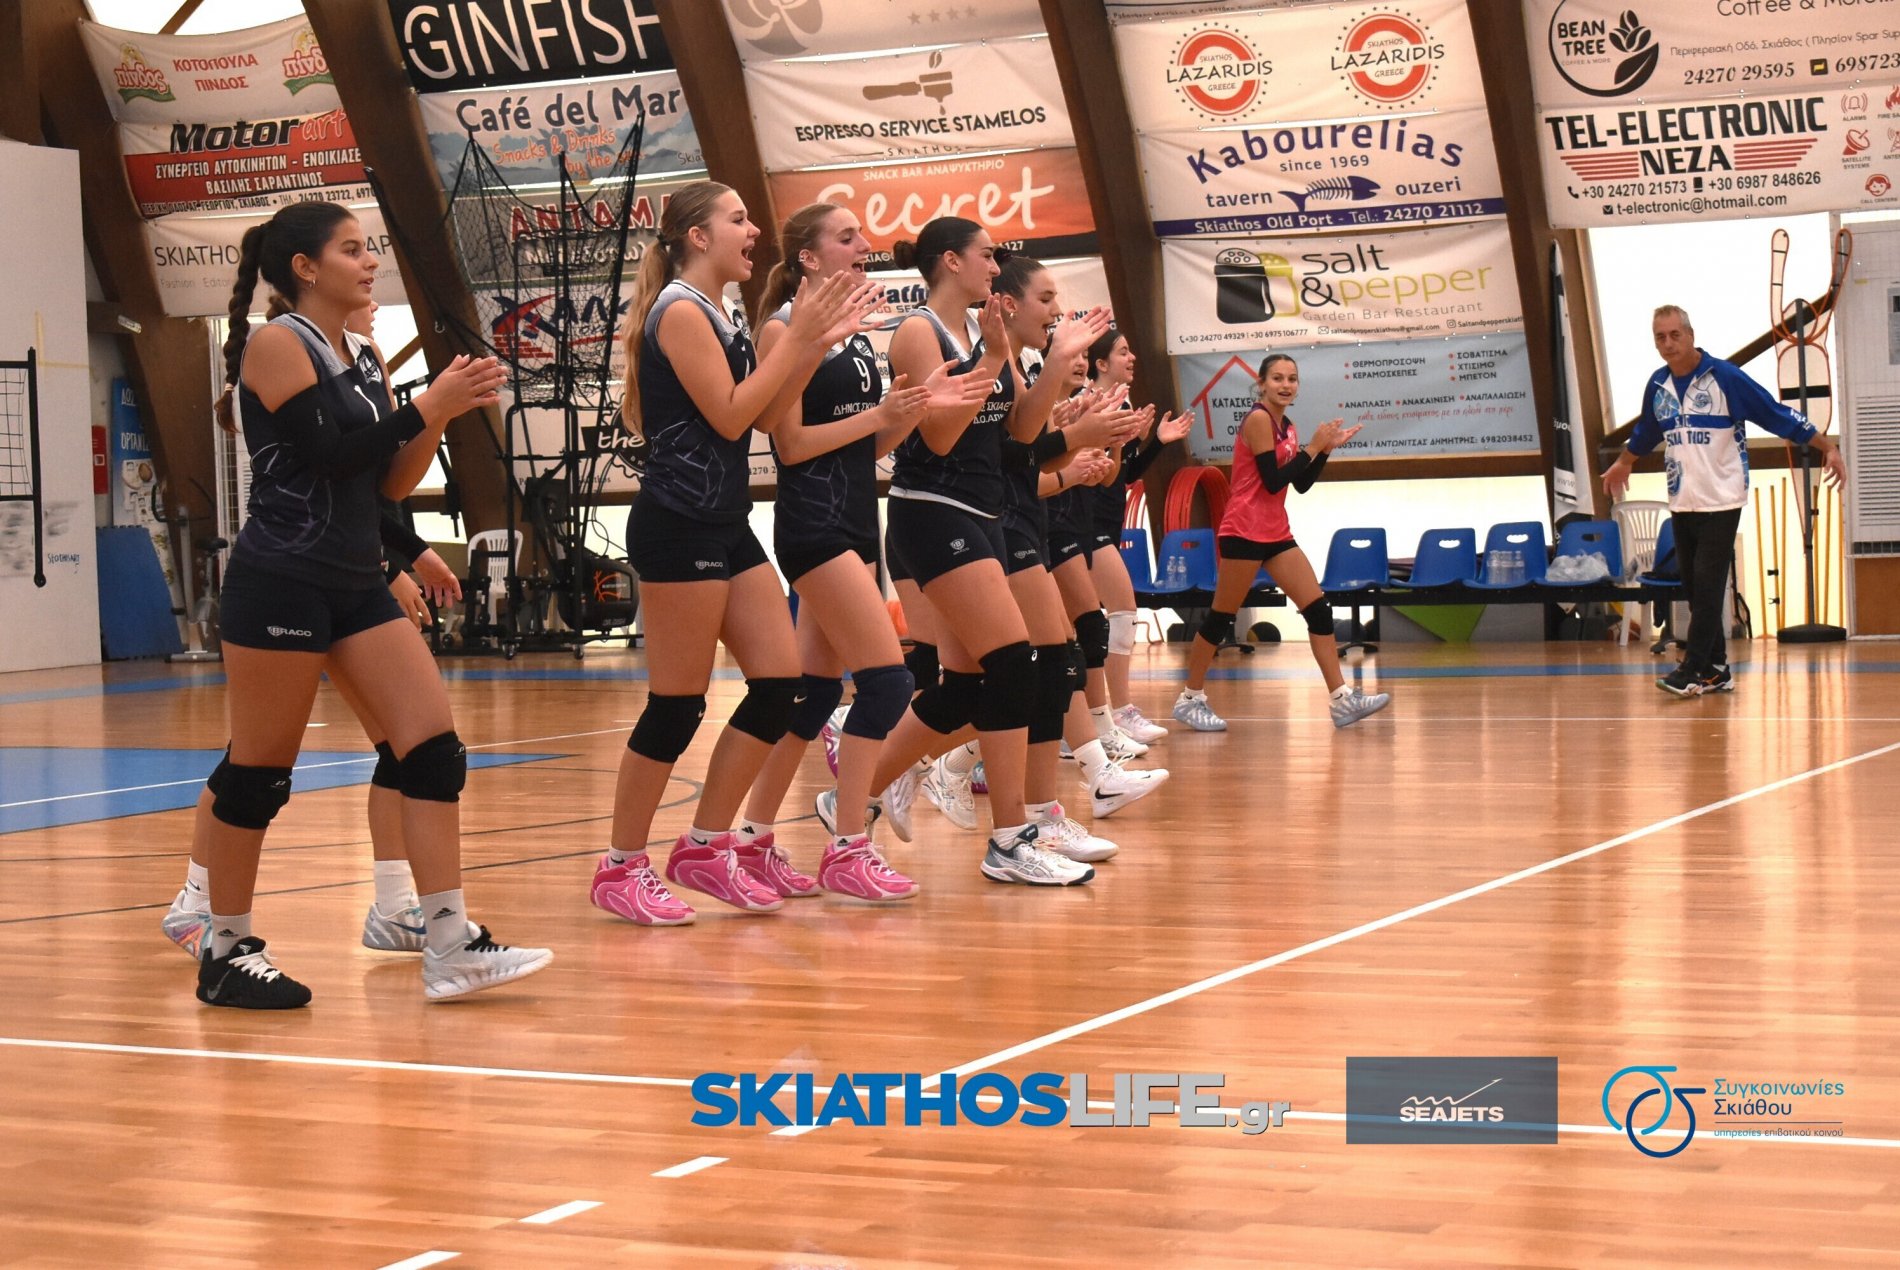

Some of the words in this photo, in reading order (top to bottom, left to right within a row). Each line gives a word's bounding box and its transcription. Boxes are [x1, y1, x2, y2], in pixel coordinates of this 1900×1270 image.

[1557, 19, 1606, 39] BEAN
[1368, 38, 1403, 48] SKIATHOS
[1562, 39, 1606, 56] TREE
[1762, 35, 1802, 50] Σκιάθος
[1855, 31, 1879, 43] Spar
[173, 54, 258, 72] ΚΟΤΟΠΟΥΛΑ
[1200, 53, 1233, 62] SKIATHOS
[1331, 44, 1444, 70] LAZARIDIS
[115, 62, 168, 92] πίνδος
[1167, 61, 1273, 83] LAZARIDIS
[1375, 68, 1404, 78] GREECE
[1684, 67, 1736, 85] 24270
[1742, 62, 1795, 80] 29595
[195, 76, 248, 91] ΠΙΝΔΟΣ
[1208, 83, 1236, 91] GREECE
[456, 97, 531, 132] Café
[545, 91, 599, 127] del
[612, 85, 681, 121] Mar
[170, 118, 300, 153] Motor
[302, 109, 346, 141] art
[795, 122, 874, 142] ESPRESSO
[879, 117, 951, 137] SERVICE
[954, 106, 1046, 131] STAMELOS
[1545, 97, 1827, 150] TEL-ELECTRONIC
[494, 139, 545, 165] Snacks
[551, 135, 563, 152] &
[566, 129, 615, 151] Drinks
[1186, 119, 1464, 184] Kabourelias
[155, 162, 209, 179] ΣΥΝΕΡΓΕΙΟ
[214, 155, 287, 175] ΑΥΤΟΚΙΝΗΤΩΝ
[587, 152, 611, 169] the
[1279, 157, 1322, 172] since
[1330, 154, 1370, 169] 1969
[1639, 144, 1732, 176] NEZA
[863, 169, 898, 181] SNACK
[902, 167, 922, 177] BAR
[926, 160, 1004, 177] ΑΝΑΨΥΚΤΗΡΙΟ
[206, 178, 252, 195] ΒΑΣΙΛΗΣ
[254, 172, 325, 191] ΣΑΡΑΝΤΙΝΟΣ
[1206, 190, 1273, 208] tavern
[1395, 176, 1462, 197] ouzeri
[1582, 185, 1604, 198] +30
[1608, 183, 1645, 197] 24270
[1650, 181, 1687, 195] 21573
[1709, 177, 1732, 191] +30
[1737, 174, 1767, 189] 6987
[1772, 171, 1821, 187] 848626
[1617, 194, 1788, 215] t-electronic@hotmail.com
[1195, 215, 1261, 233] Skiathos
[1266, 213, 1294, 229] Old
[1299, 212, 1333, 227] Port
[1383, 206, 1433, 221] 24270
[1439, 203, 1485, 217] 21112
[1302, 244, 1390, 275] salt
[1303, 310, 1355, 322] Garden
[1363, 308, 1388, 320] Bar
[1395, 302, 1483, 318] Restaurant
[1200, 333, 1222, 342] 24270
[1224, 332, 1245, 340] 49329
[1352, 357, 1425, 368] ΘΕΡΜΟΠΡΟΣΟΨΗ
[1457, 350, 1507, 360] ΣΟΒΑΤΙΣΜΑ
[853, 357, 871, 393] 9
[1352, 369, 1417, 379] ΚΕΡΑΜΟΣΚΕΠΕΣ
[1457, 361, 1495, 370] ΧΤΙΣΙΜΟ
[1459, 372, 1497, 381] ΜΠΕΤΟΝ
[1345, 400, 1391, 408] ΑΝΑΠΛΑΣΗ
[1402, 395, 1455, 406] ΑΝΑΚΑΙΝΙΣΗ
[1466, 391, 1526, 401] ΑΝΑΠΑΛΑΙΩΣΗ
[1480, 434, 1533, 444] 6982038452
